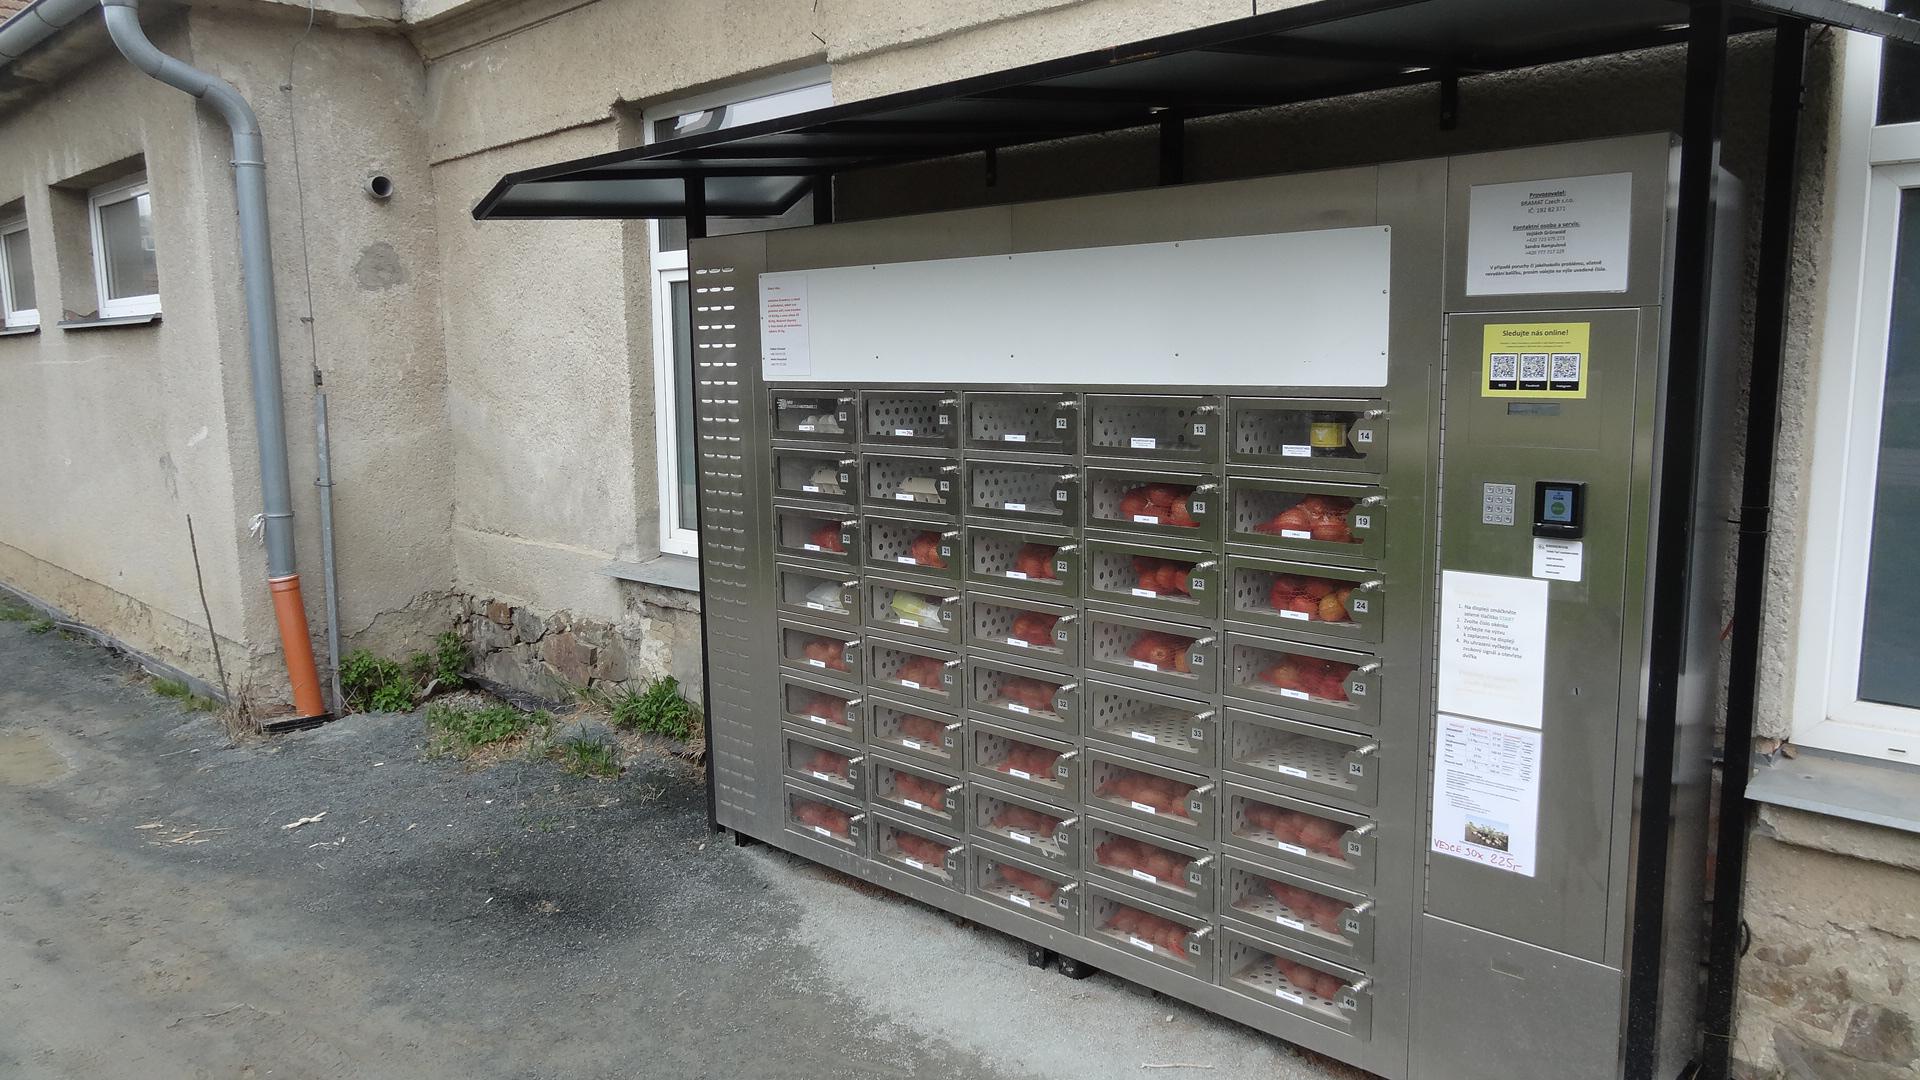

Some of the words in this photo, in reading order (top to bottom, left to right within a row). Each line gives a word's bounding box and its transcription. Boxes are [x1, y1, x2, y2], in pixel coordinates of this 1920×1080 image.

[1193, 729, 1201, 737] 33
[1351, 764, 1360, 773] 34
[1192, 802, 1200, 810] 38
[1350, 844, 1359, 852] 39
[1192, 873, 1200, 881] 43
